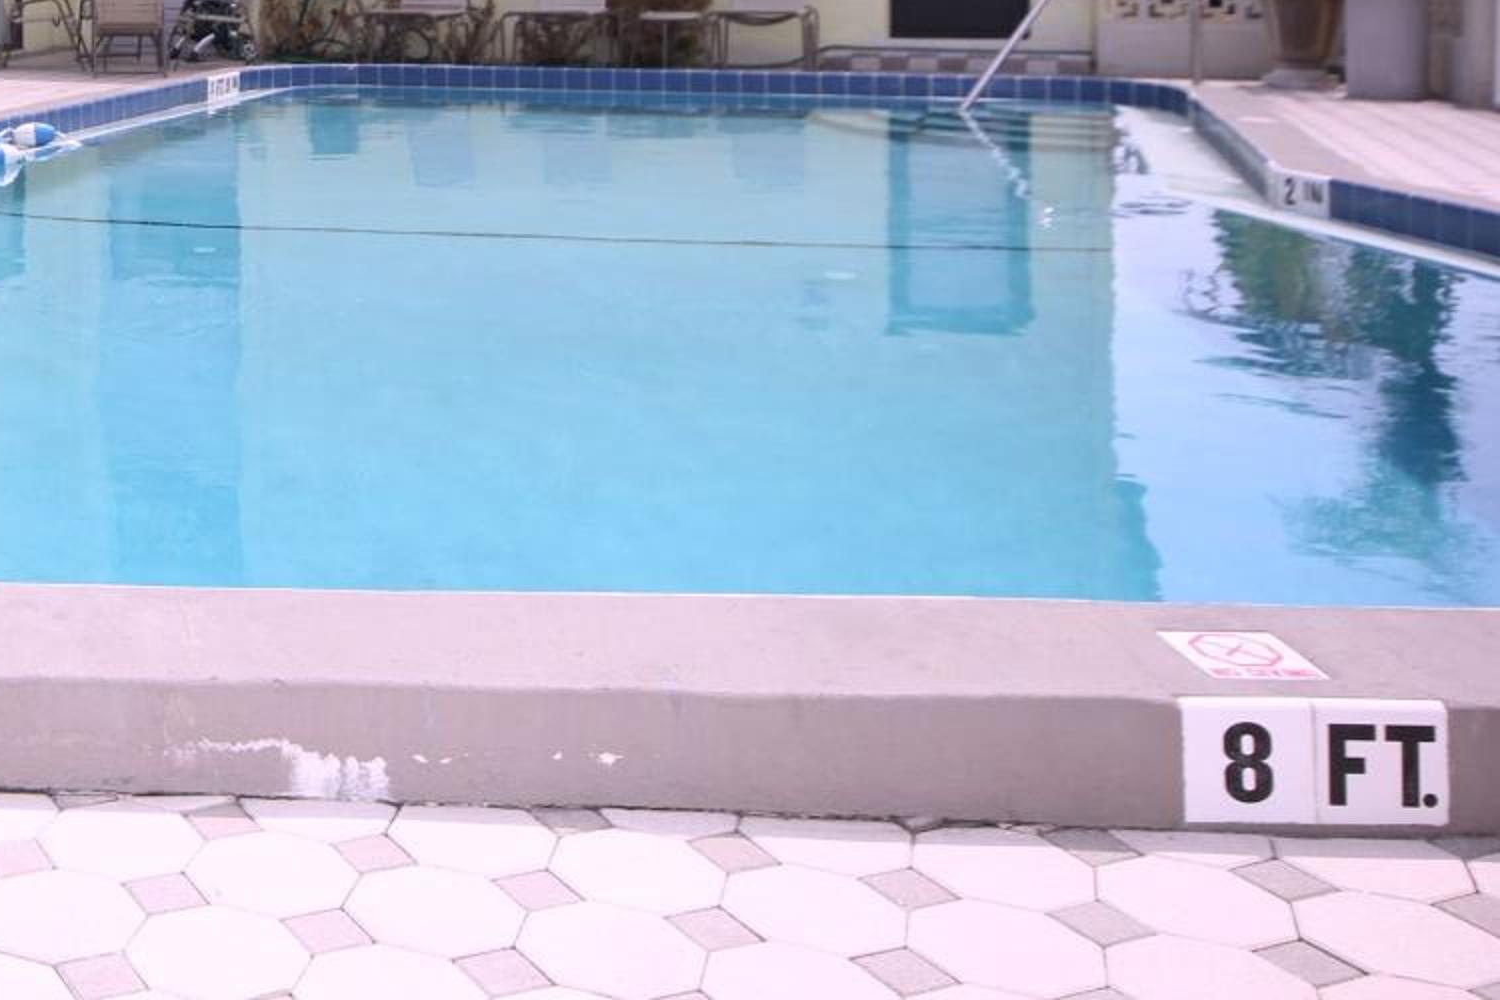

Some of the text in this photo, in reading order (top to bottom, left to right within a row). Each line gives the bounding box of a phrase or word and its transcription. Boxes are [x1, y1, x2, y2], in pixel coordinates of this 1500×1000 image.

[1285, 177, 1297, 206] 2
[1223, 721, 1439, 808] 8 FT.
